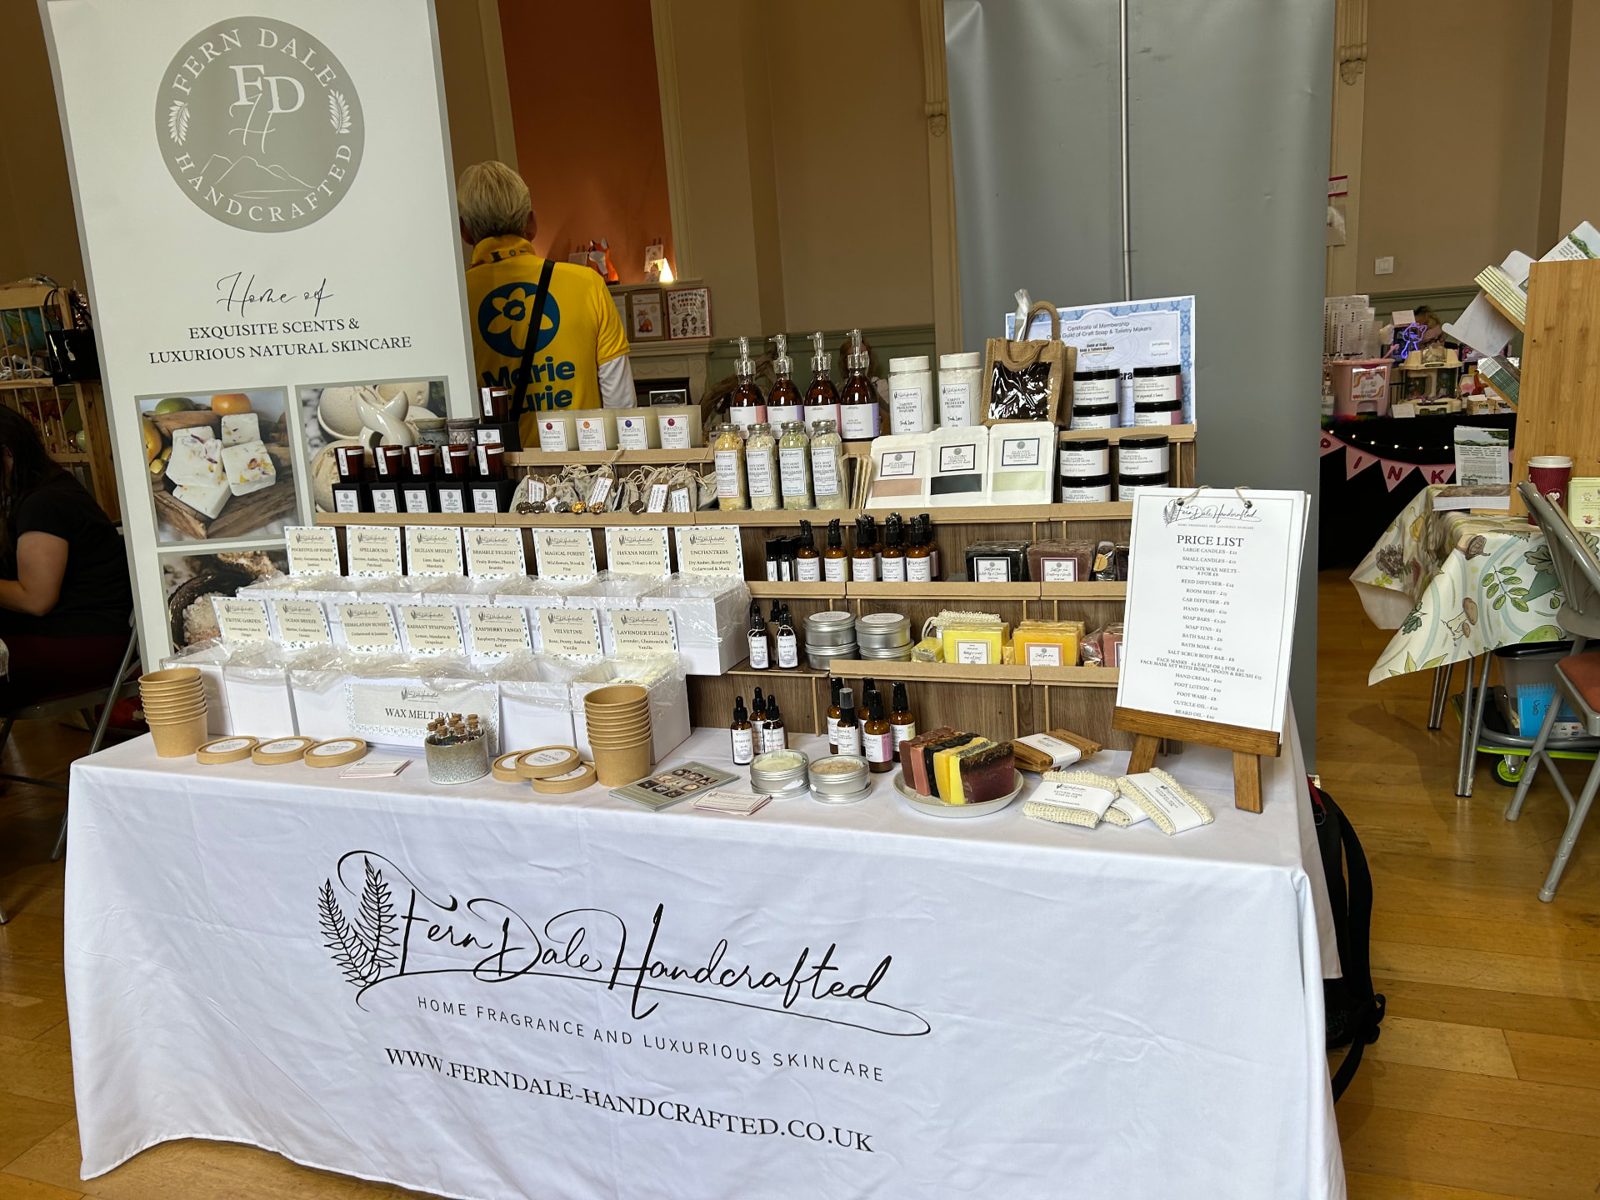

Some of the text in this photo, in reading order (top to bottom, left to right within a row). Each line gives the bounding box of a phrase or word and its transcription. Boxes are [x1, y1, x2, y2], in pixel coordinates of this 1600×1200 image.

[172, 27, 338, 97] FERN DALE
[174, 143, 353, 223] HANDCRAFTED
[216, 271, 334, 318] Home of
[149, 335, 412, 365] LUXURIOUS NATURAL SKINCARE
[189, 317, 360, 341] EXQUISITE SCENTS &
[1177, 535, 1244, 547] PRICE LIST
[385, 708, 406, 718] WAX
[408, 711, 435, 720] MELT
[467, 898, 602, 982] Dale
[580, 903, 895, 1019] Handcrafted
[417, 996, 885, 1083] HOME FRAGRANCE AND LUXURIOUS SKINCARE
[385, 1047, 875, 1153] WWW.FERNDALE-HANDCRAFTED.CO.UK
